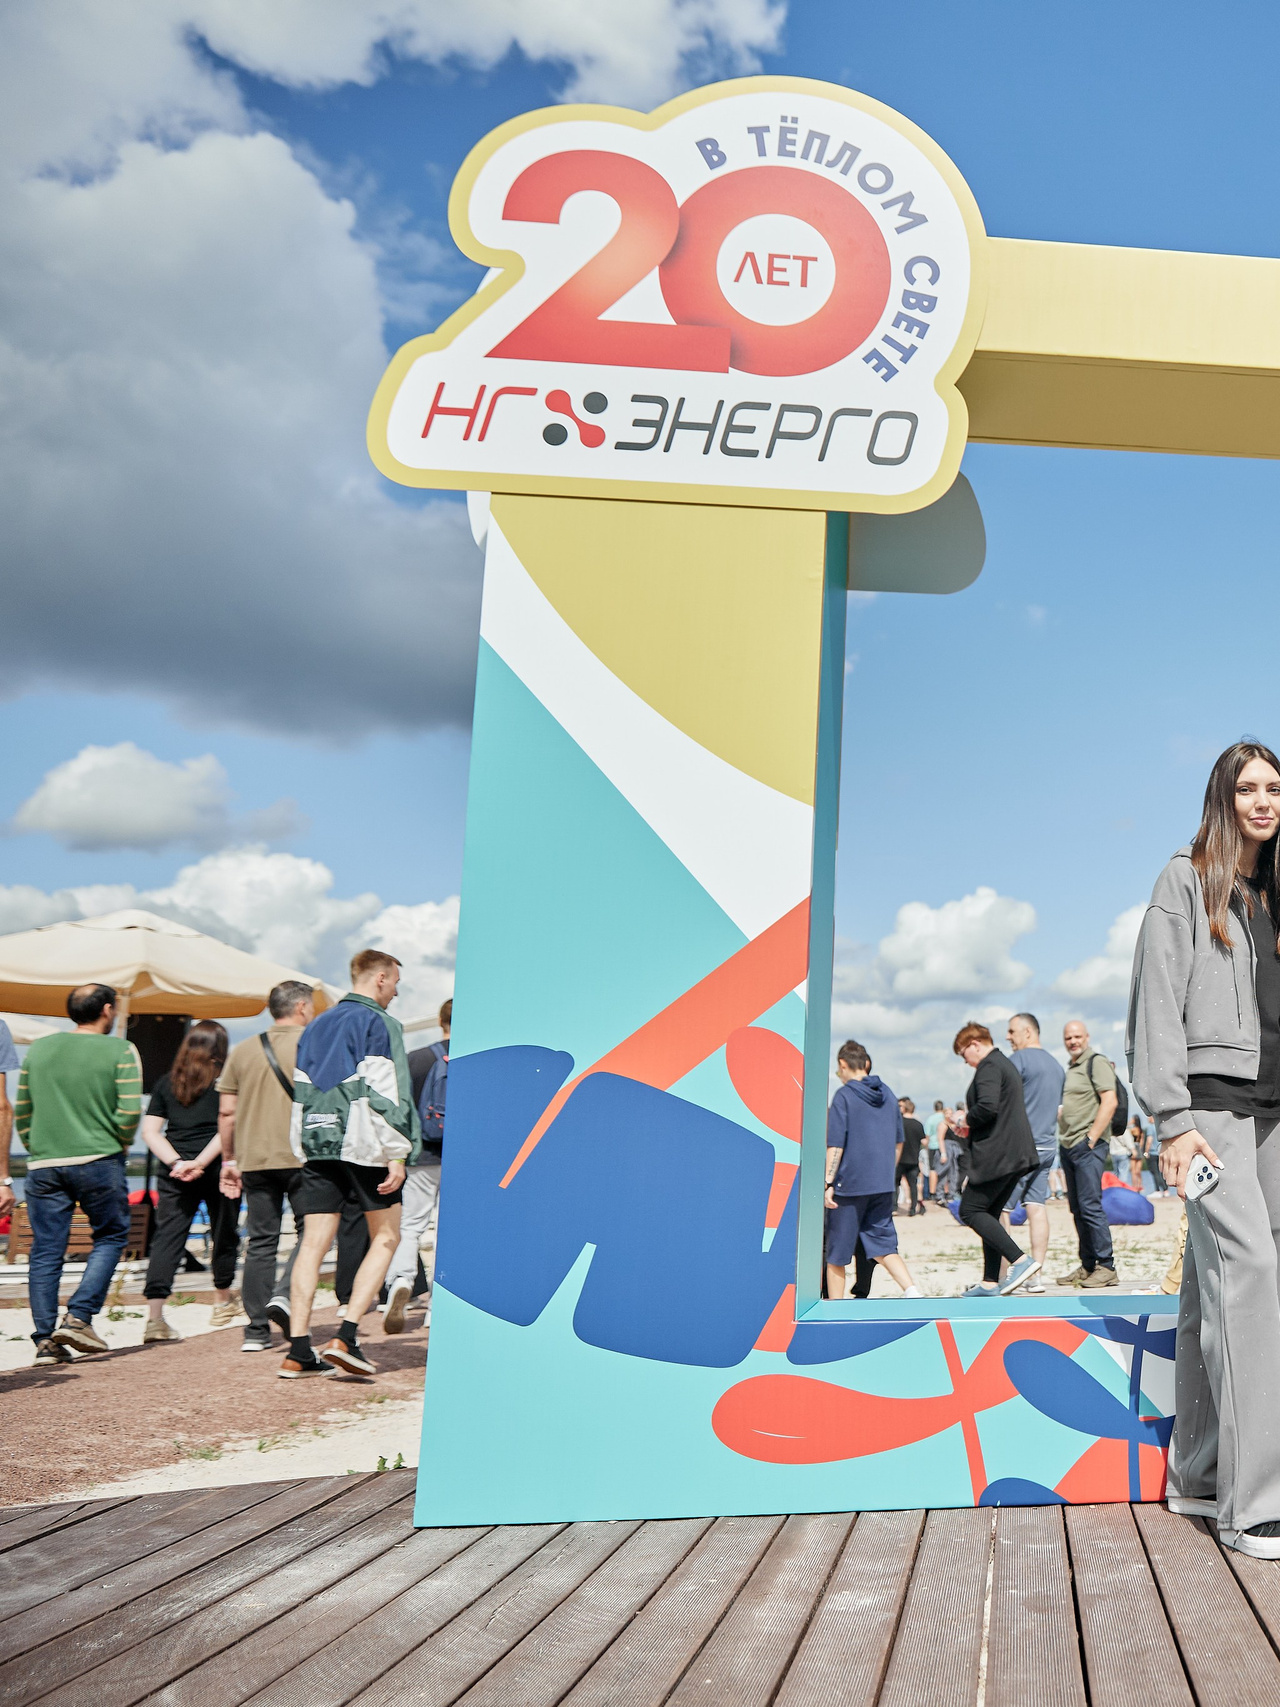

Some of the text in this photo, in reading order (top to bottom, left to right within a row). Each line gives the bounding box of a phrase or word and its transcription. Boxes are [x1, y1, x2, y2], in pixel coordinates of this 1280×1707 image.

[483, 149, 892, 378] 20
[695, 114, 941, 383] В ТЁПЛОМ СВЕТЕ
[733, 250, 818, 288] ЛЕТ
[613, 393, 919, 466] ЭНЕРГО
